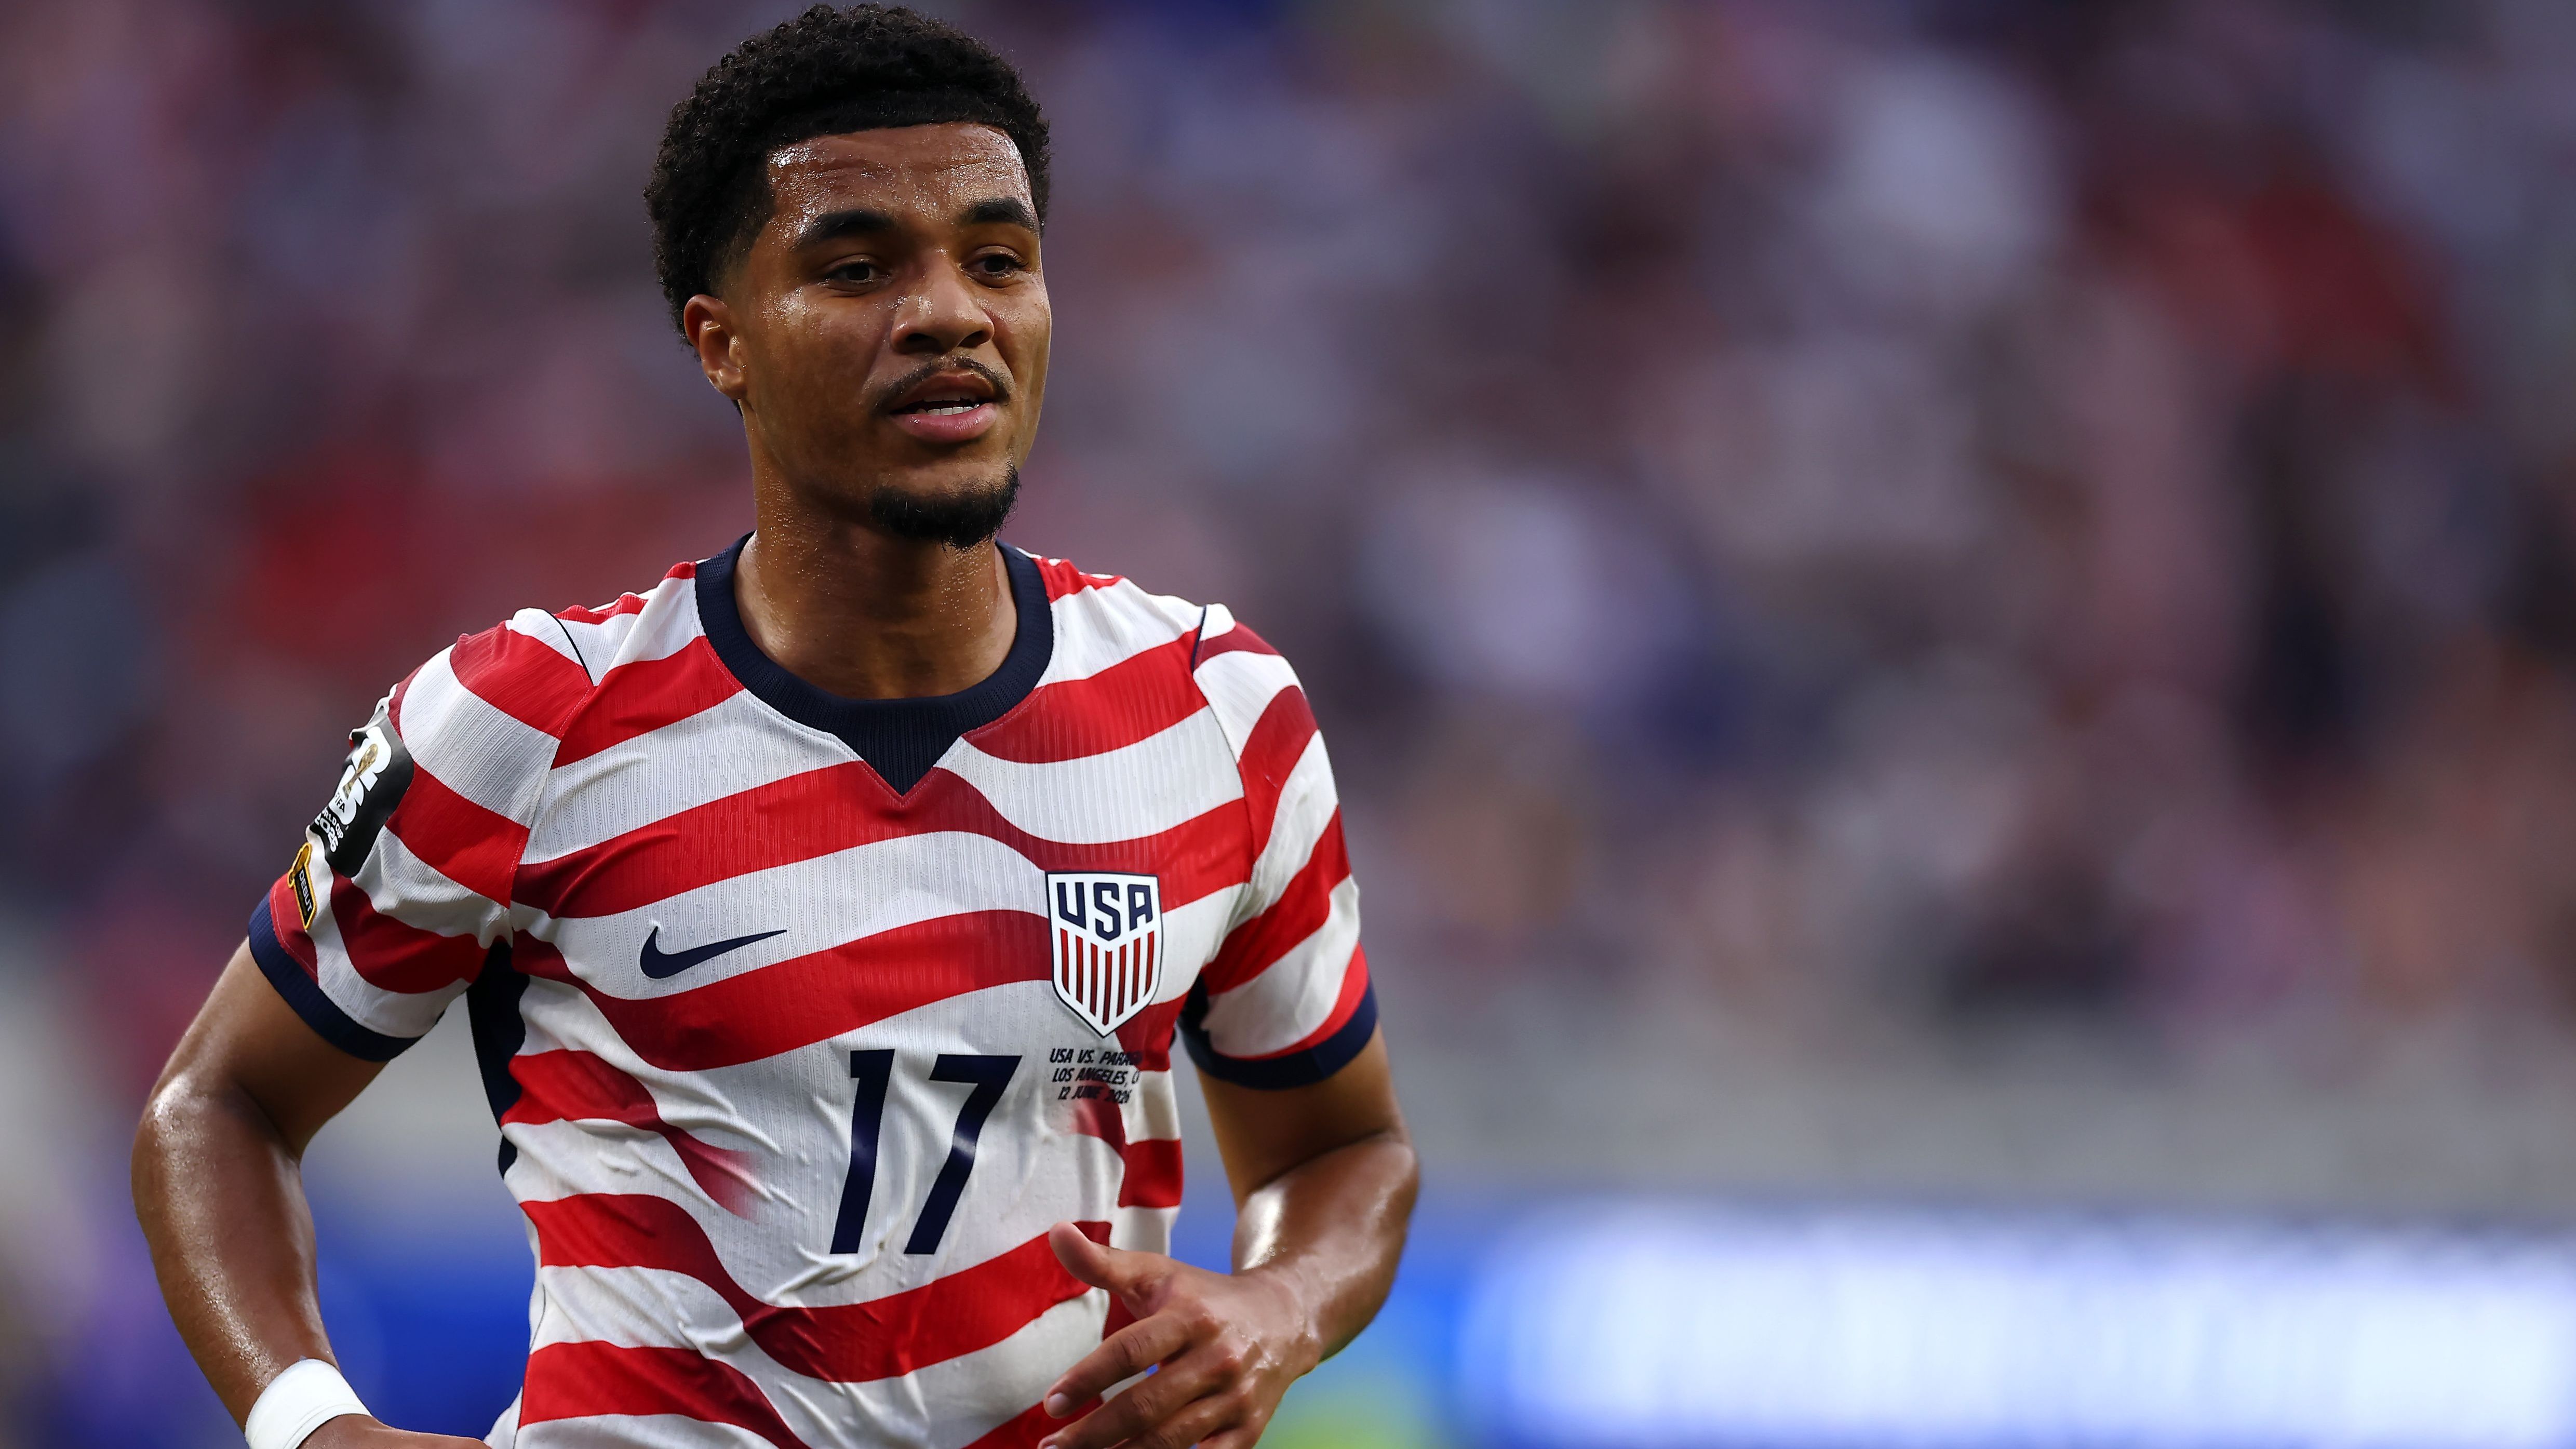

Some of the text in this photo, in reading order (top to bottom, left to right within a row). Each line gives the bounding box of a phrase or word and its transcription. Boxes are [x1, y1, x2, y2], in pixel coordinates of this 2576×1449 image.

[334, 792, 345, 813] FIFA
[314, 812, 339, 852] 2026
[321, 807, 344, 839] RLD CUP
[299, 869, 312, 912] DEBUT
[1056, 882, 1153, 942] USA
[1050, 1048, 1074, 1064] USA
[1077, 1049, 1095, 1064] VS.
[1052, 1068, 1075, 1083] LOS
[1075, 1068, 1128, 1088] ANGELES,
[1057, 1086, 1071, 1100] 12
[1071, 1085, 1104, 1099] JUNE
[829, 1049, 1022, 1255] 17
